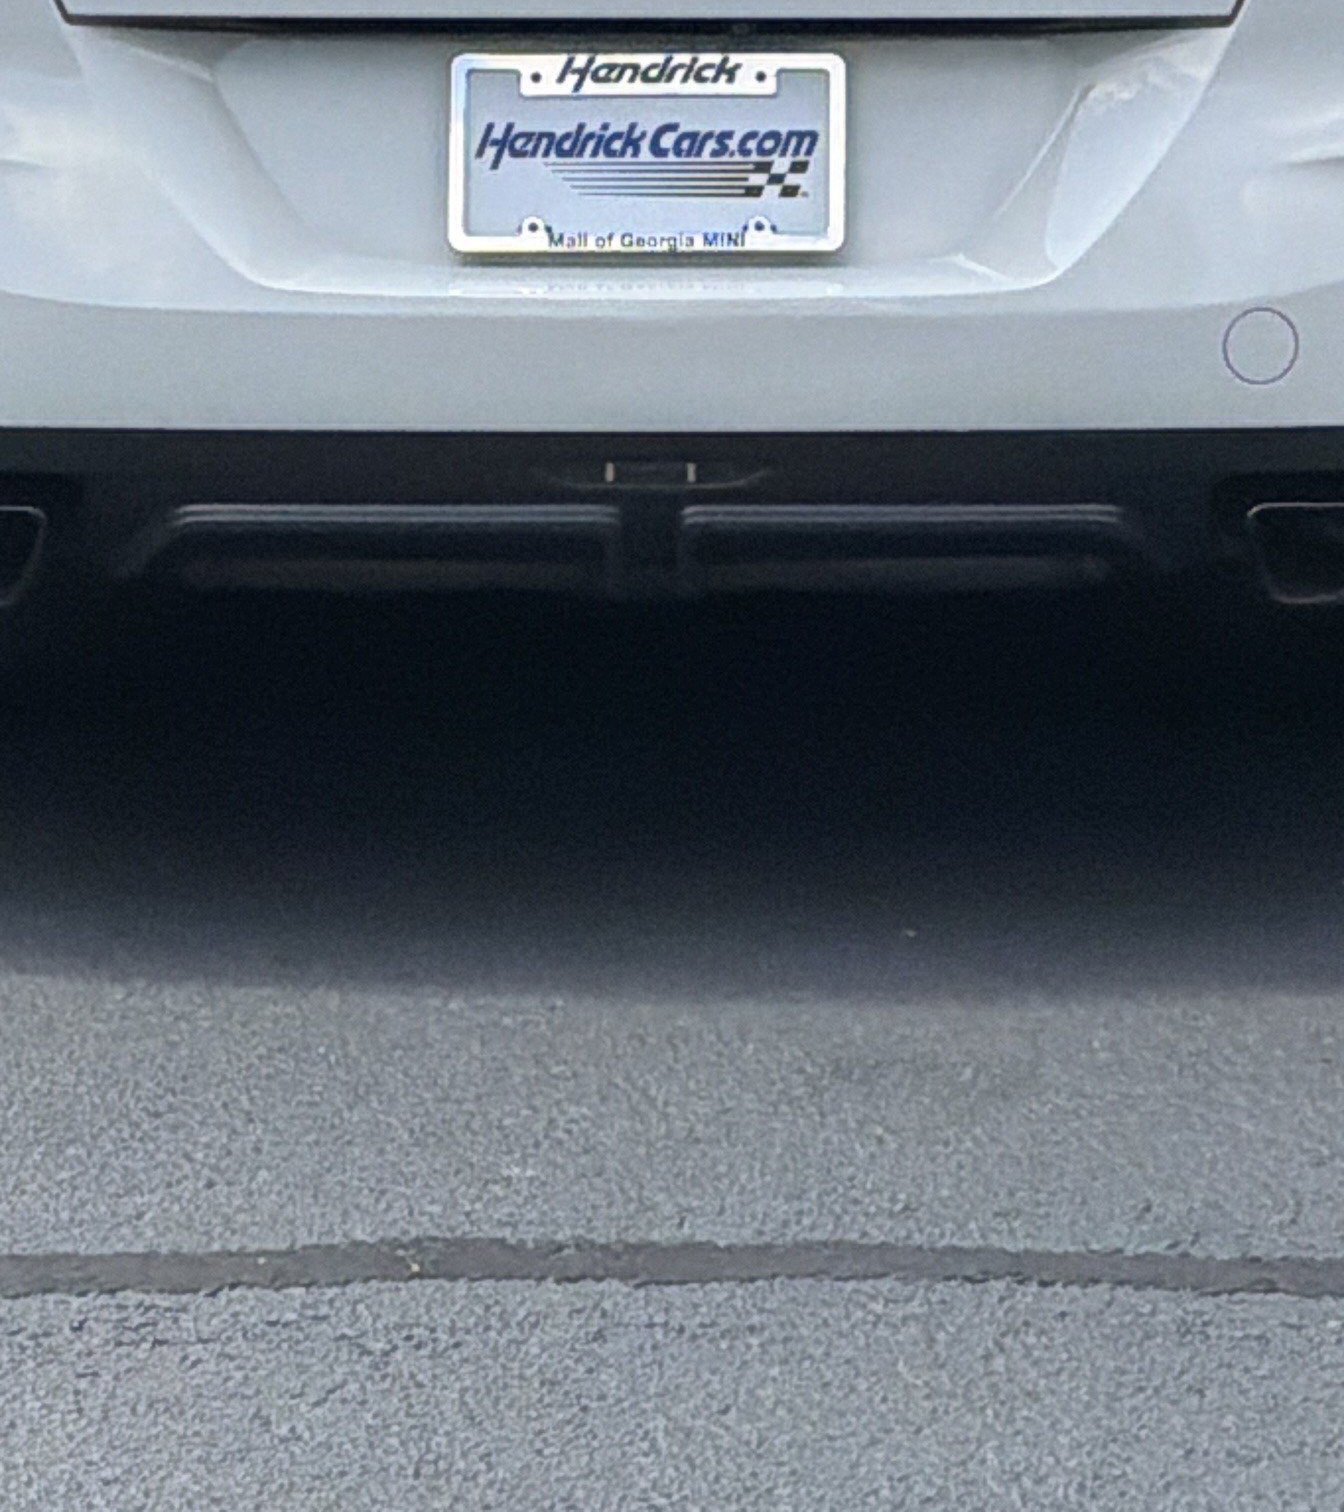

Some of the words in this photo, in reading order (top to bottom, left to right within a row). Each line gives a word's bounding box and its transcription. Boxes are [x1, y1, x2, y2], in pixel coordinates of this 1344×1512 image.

[555, 55, 743, 93] Hendrick
[549, 231, 588, 248] Mall
[594, 231, 615, 249] of
[620, 231, 695, 253] Georgia
[703, 231, 746, 248] MINI
